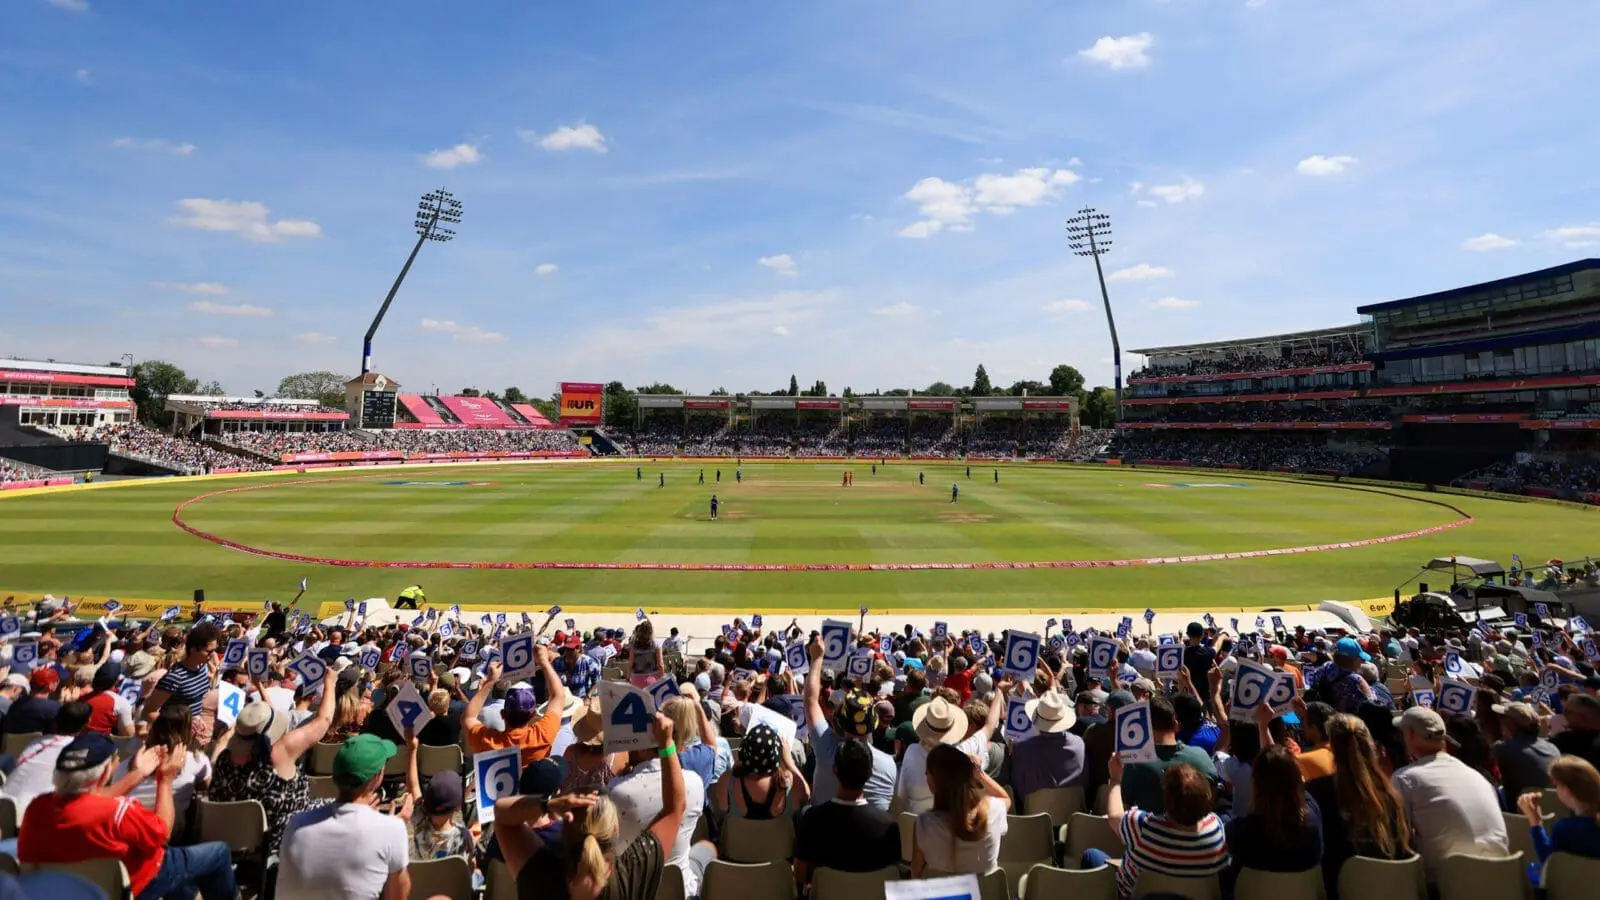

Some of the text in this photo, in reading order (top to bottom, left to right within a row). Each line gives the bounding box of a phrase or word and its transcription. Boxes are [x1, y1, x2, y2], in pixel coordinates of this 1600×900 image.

[1, 617, 16, 632] 6
[499, 614, 505, 623] 6
[754, 616, 761, 625] 6
[441, 625, 450, 635] 6
[779, 632, 786, 640] 6
[937, 625, 945, 635] 6
[1119, 626, 1126, 636] 6
[229, 643, 244, 661] 6
[396, 644, 405, 656] 6
[466, 641, 476, 652] 6
[825, 629, 847, 658] 6
[881, 637, 890, 649] 6
[971, 637, 980, 649] 6
[17, 646, 33, 661] 6
[367, 652, 377, 666] 6
[506, 640, 528, 668] 6
[789, 647, 803, 665] 6
[1010, 640, 1032, 669] 6
[1093, 643, 1112, 667] 6
[1161, 649, 1179, 670] 6
[250, 654, 264, 674] 6
[300, 656, 324, 683] 6
[414, 661, 429, 676] 6
[853, 659, 868, 673] 6
[1545, 672, 1557, 687] 6
[1237, 673, 1265, 705] 6
[1271, 676, 1290, 702] 6
[1445, 687, 1466, 709] 6
[223, 692, 241, 717] 4
[611, 692, 653, 733] 4
[398, 700, 422, 728] 4
[1011, 704, 1029, 729] 6
[1120, 712, 1145, 746] 6
[484, 759, 514, 800] 6
